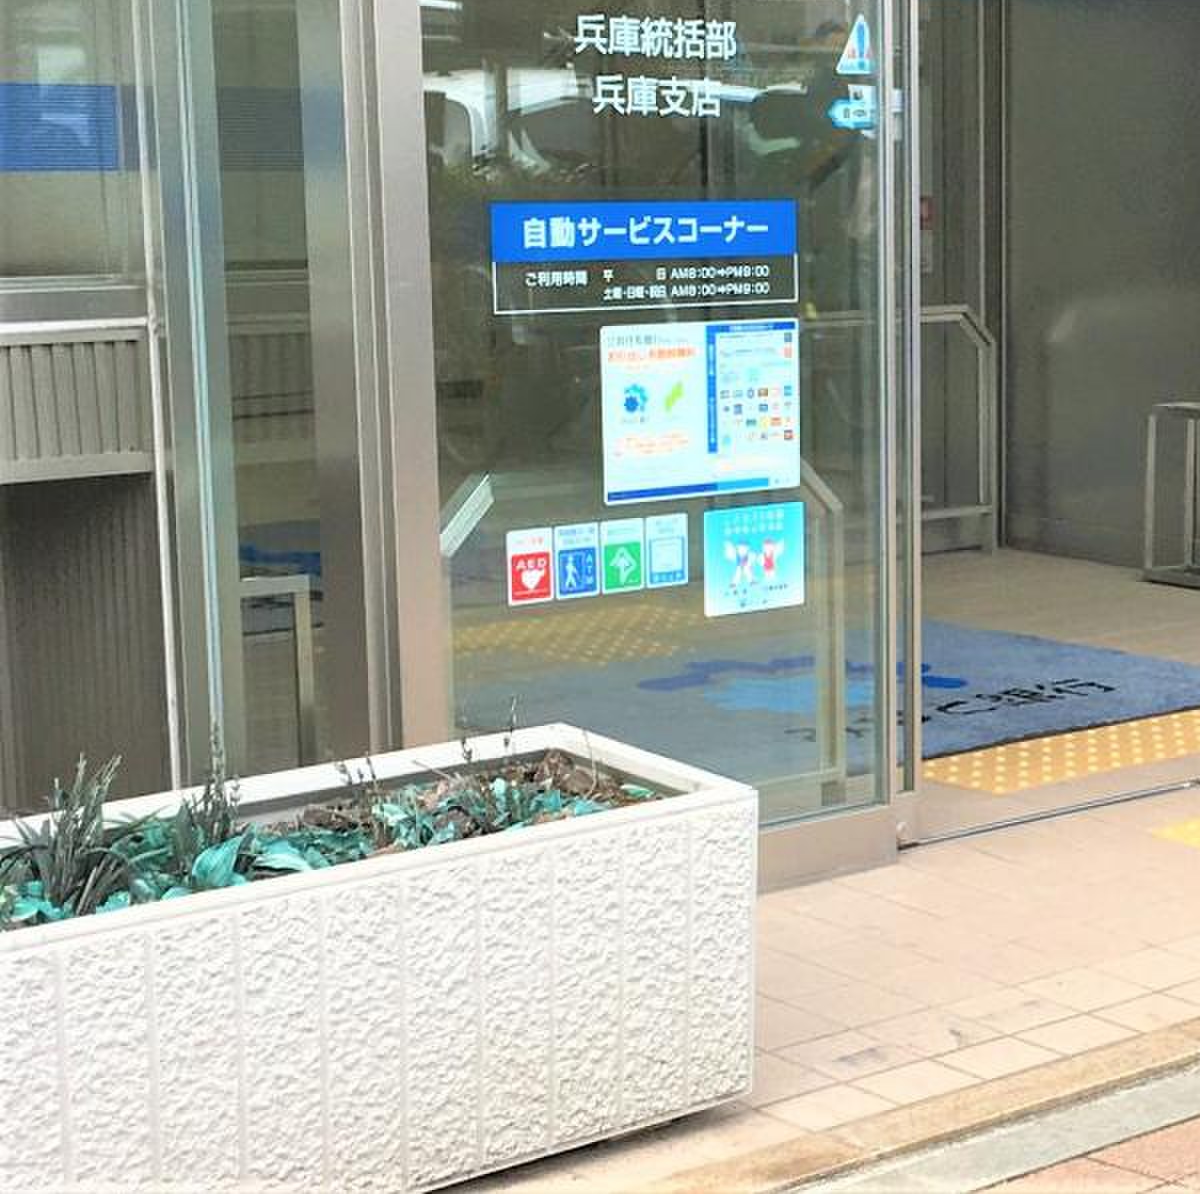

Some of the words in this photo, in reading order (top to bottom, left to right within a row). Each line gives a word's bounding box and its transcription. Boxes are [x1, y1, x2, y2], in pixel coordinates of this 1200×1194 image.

[574, 14, 738, 61] 兵庫統括部
[592, 74, 722, 118] 兵庫支店
[522, 215, 769, 250] 自動サービスコーナー
[525, 270, 588, 287] ご利用時間
[515, 557, 547, 571] AED
